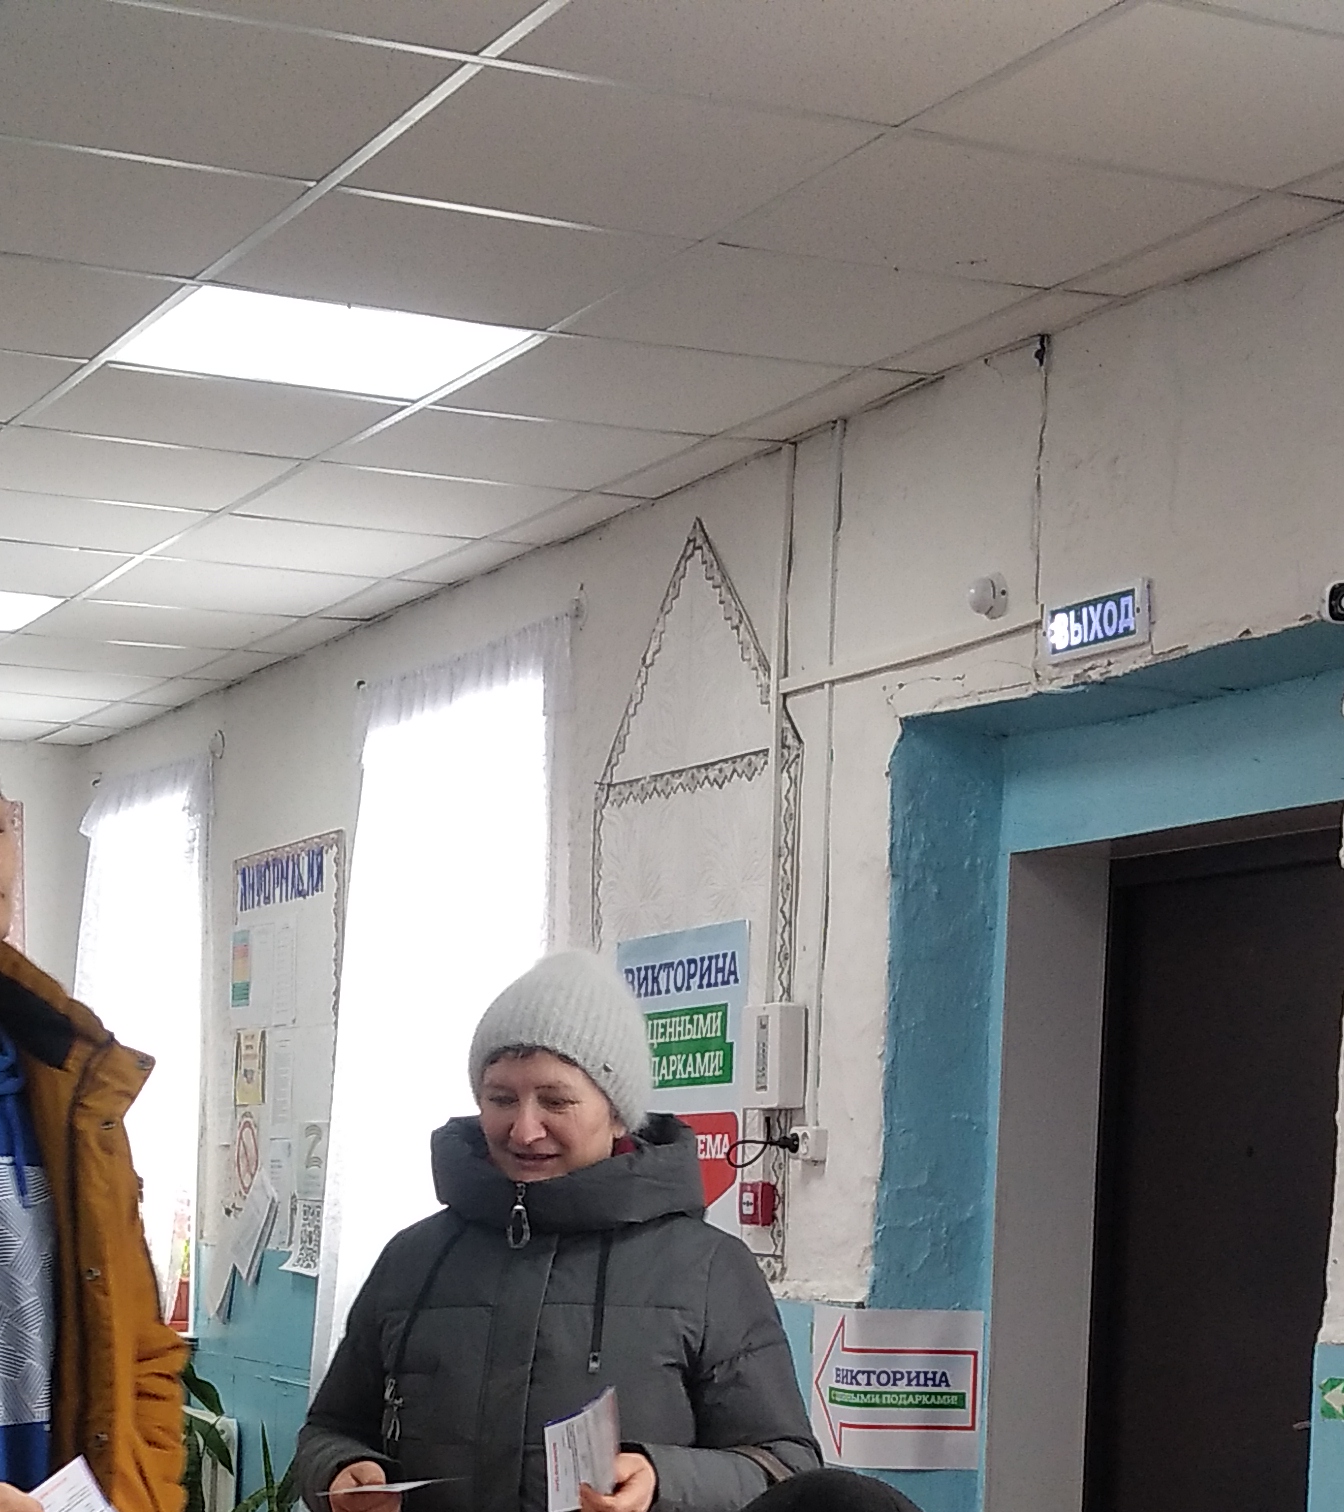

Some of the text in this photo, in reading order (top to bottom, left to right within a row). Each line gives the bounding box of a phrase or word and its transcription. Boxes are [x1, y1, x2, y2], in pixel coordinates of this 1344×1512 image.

[1056, 595, 1135, 650] ВЫХОД
[624, 951, 740, 998] ВИКТОРИНА
[648, 1011, 722, 1044] ЦЕННЫМИ
[834, 1367, 951, 1388] ВИКТОРИНА
